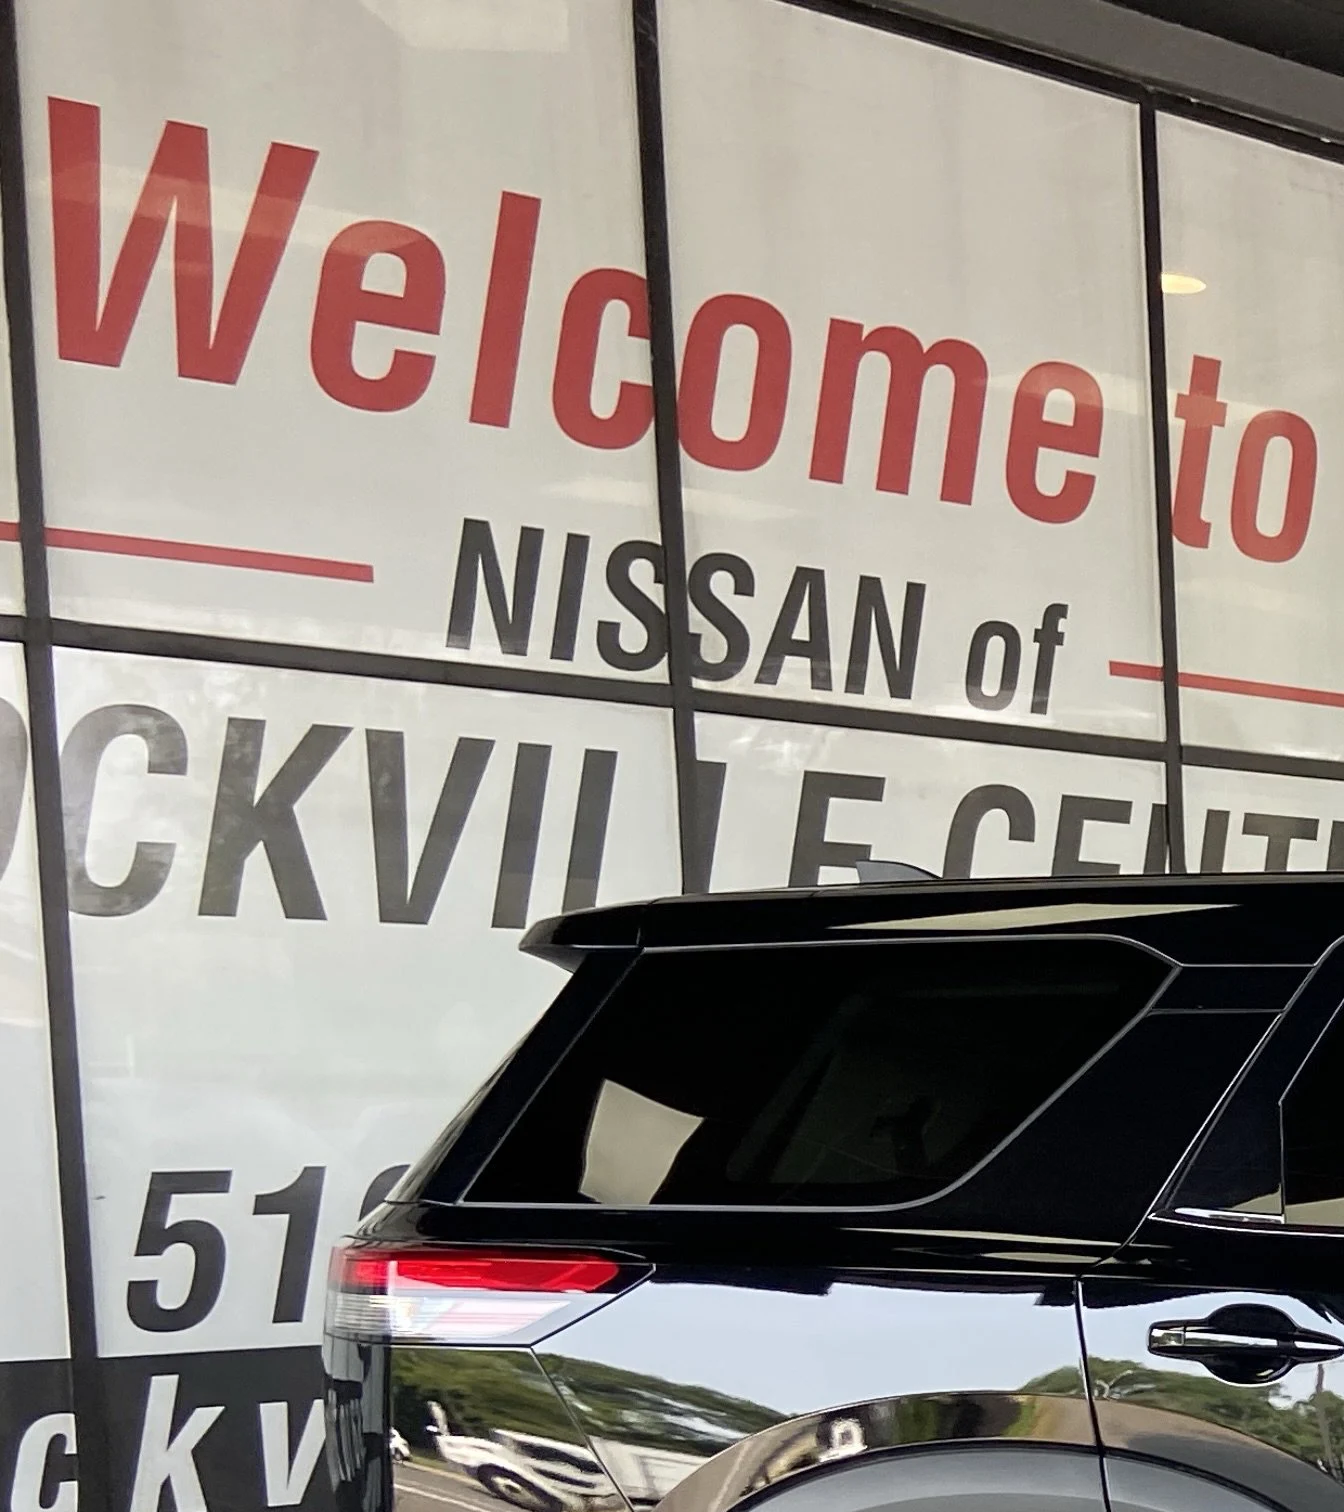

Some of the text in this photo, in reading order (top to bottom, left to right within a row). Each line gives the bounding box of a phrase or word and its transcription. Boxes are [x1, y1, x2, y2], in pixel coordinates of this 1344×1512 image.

[46, 95, 1319, 564] Welcome to
[446, 517, 1068, 716] NISSAN of
[126, 1164, 412, 1333] 51
